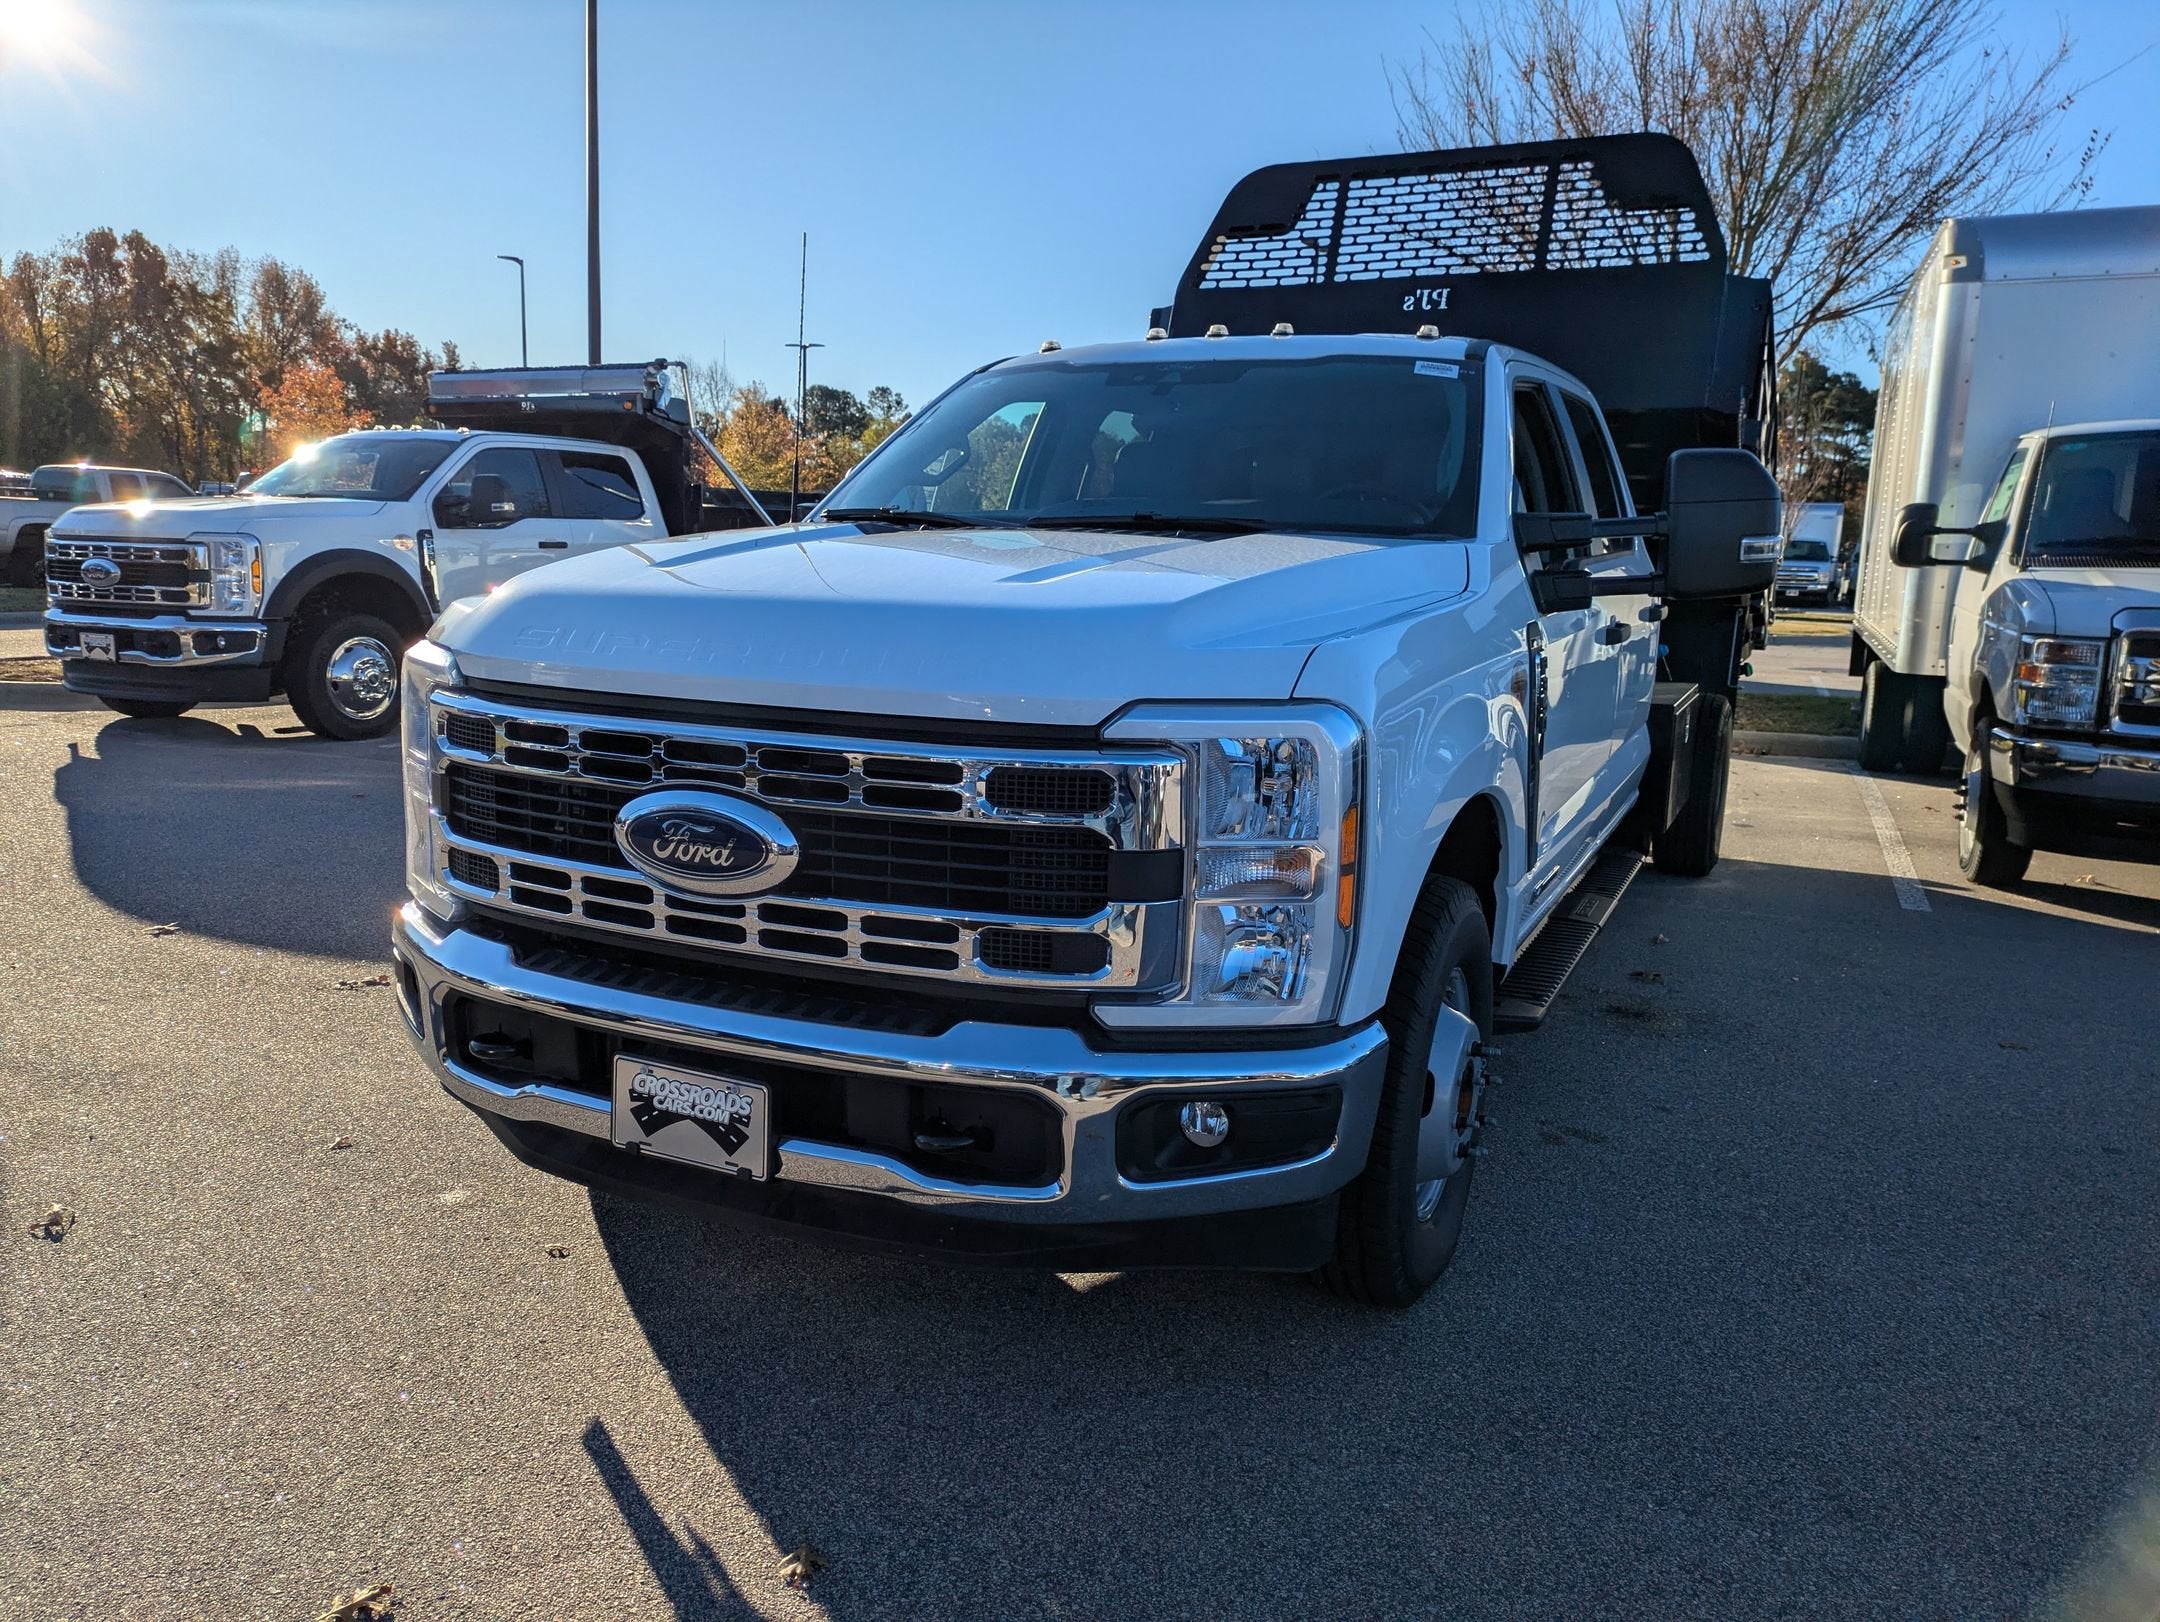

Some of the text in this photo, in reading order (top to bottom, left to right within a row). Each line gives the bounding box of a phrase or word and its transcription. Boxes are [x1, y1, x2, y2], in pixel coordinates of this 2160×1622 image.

[652, 819, 736, 867] Ford
[631, 1072, 754, 1117] CROSSROADS
[652, 1095, 731, 1126] CARS.COM
